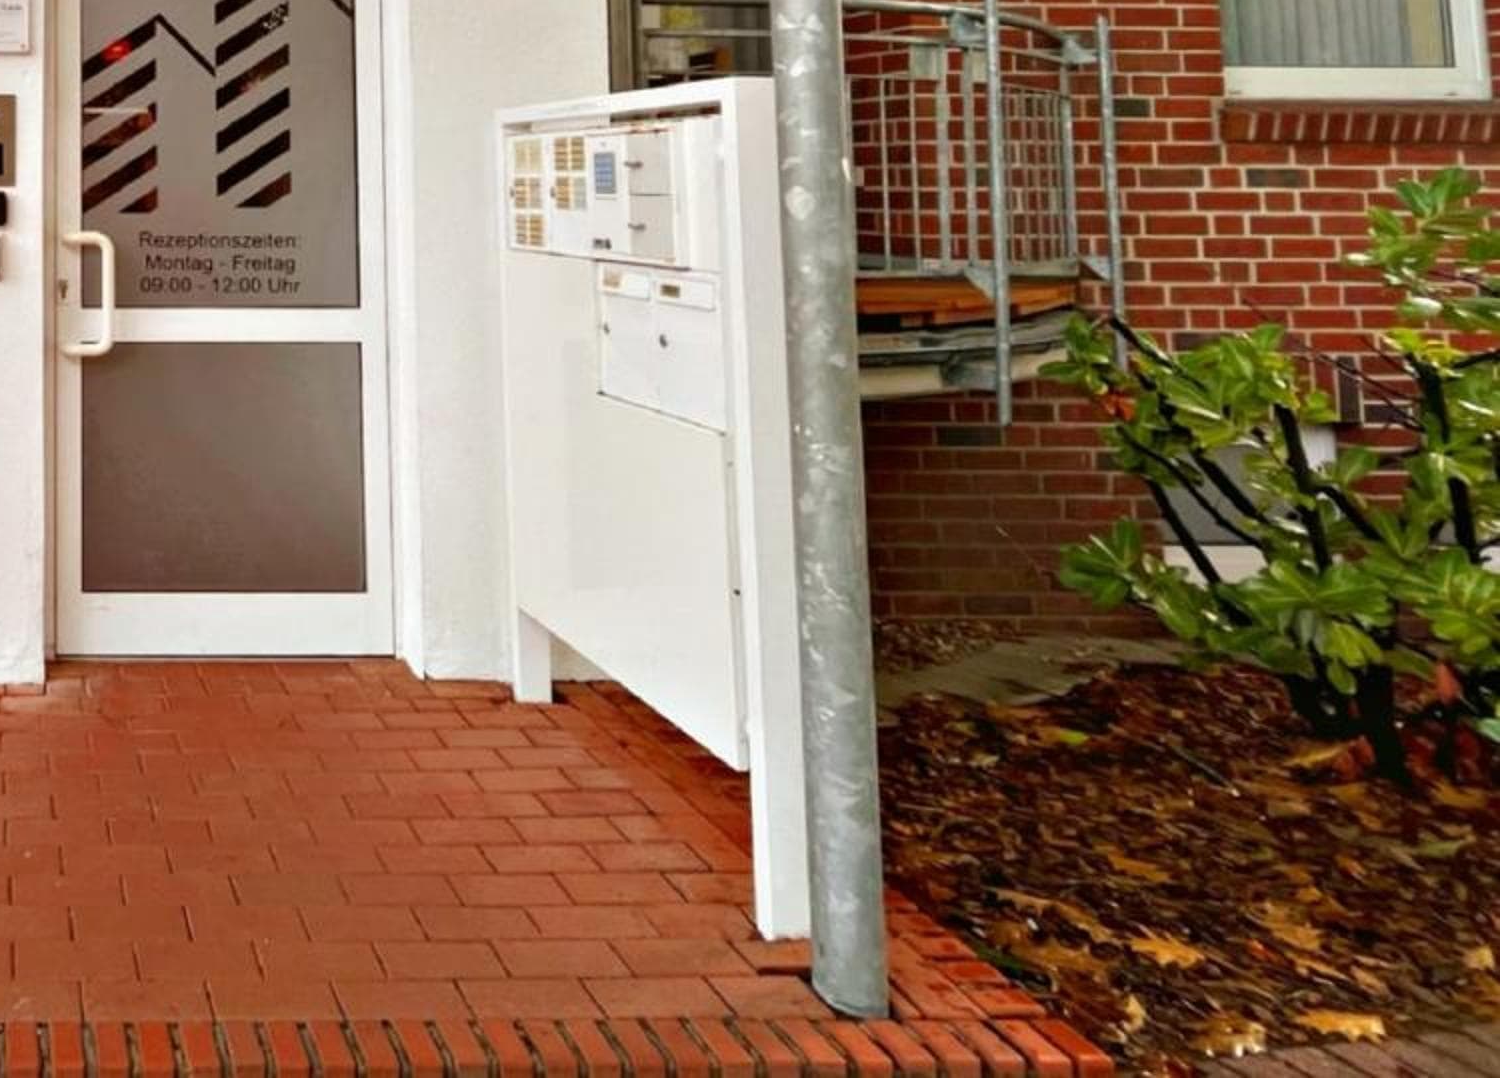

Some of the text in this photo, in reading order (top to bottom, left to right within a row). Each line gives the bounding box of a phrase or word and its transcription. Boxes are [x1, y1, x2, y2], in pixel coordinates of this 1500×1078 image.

[144, 254, 213, 274] Montag
[232, 254, 296, 275] Freitag
[211, 276, 263, 294] 12:00
[267, 277, 302, 294] Uhr
